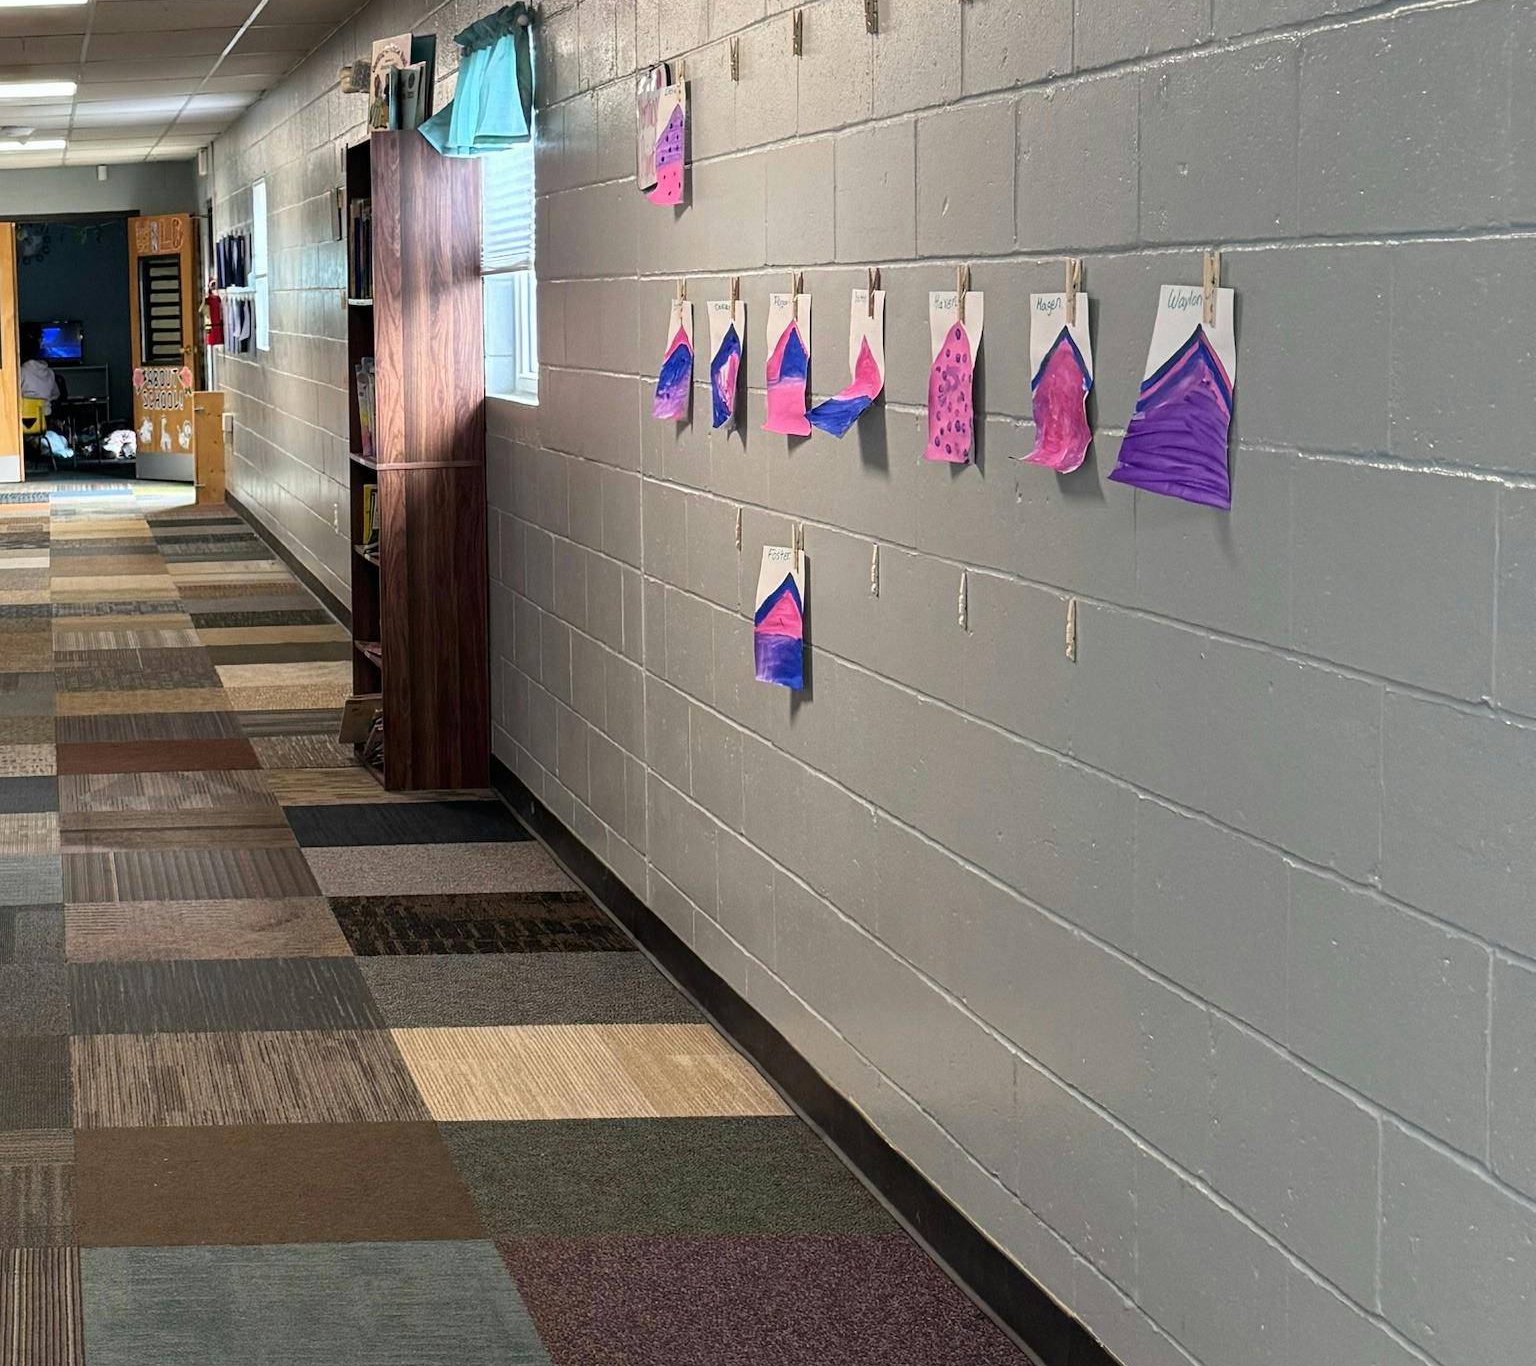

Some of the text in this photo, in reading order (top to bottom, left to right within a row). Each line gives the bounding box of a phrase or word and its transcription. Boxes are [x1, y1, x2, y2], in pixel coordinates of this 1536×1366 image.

[1167, 288, 1203, 311] Waylon
[142, 367, 179, 389] ABOUT
[768, 547, 792, 561] Foster
